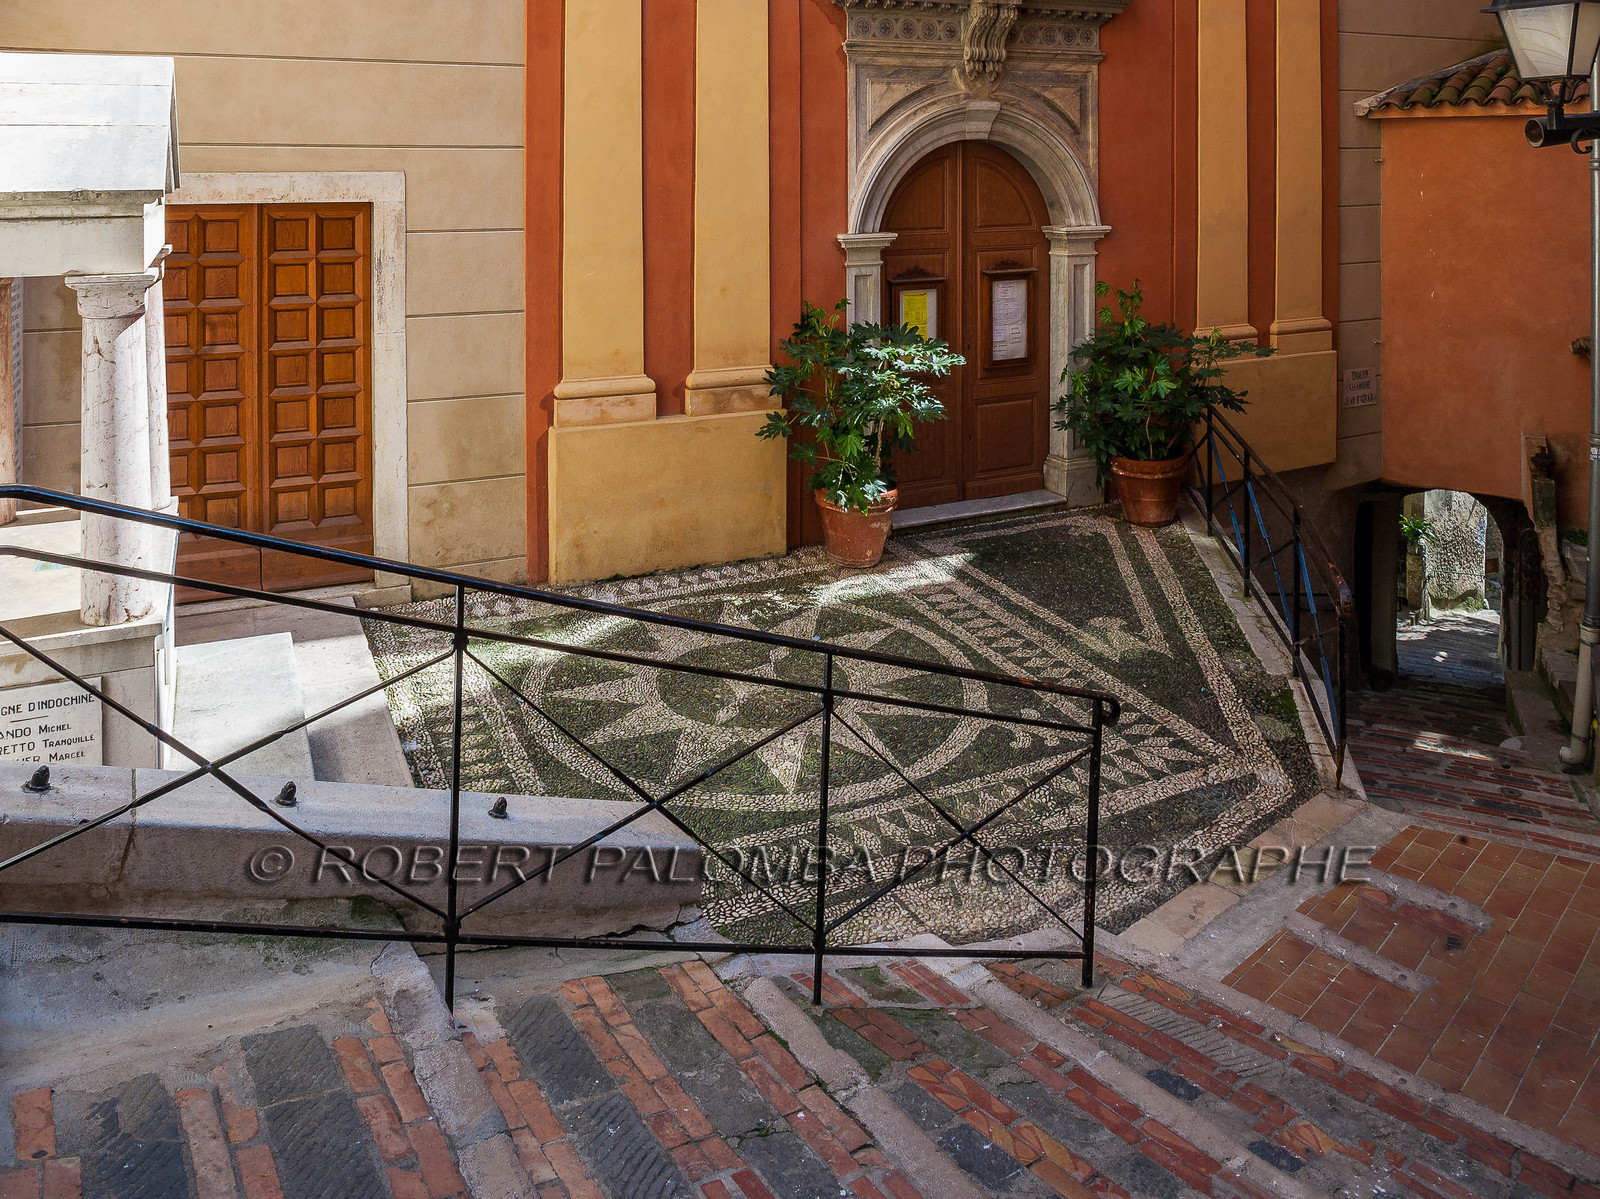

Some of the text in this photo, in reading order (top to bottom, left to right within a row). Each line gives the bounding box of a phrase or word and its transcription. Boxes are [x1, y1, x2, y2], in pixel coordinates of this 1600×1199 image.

[38, 724, 72, 734] MICHEL
[42, 734, 95, 748] TRANQUILLE
[49, 751, 85, 762] MARCEL
